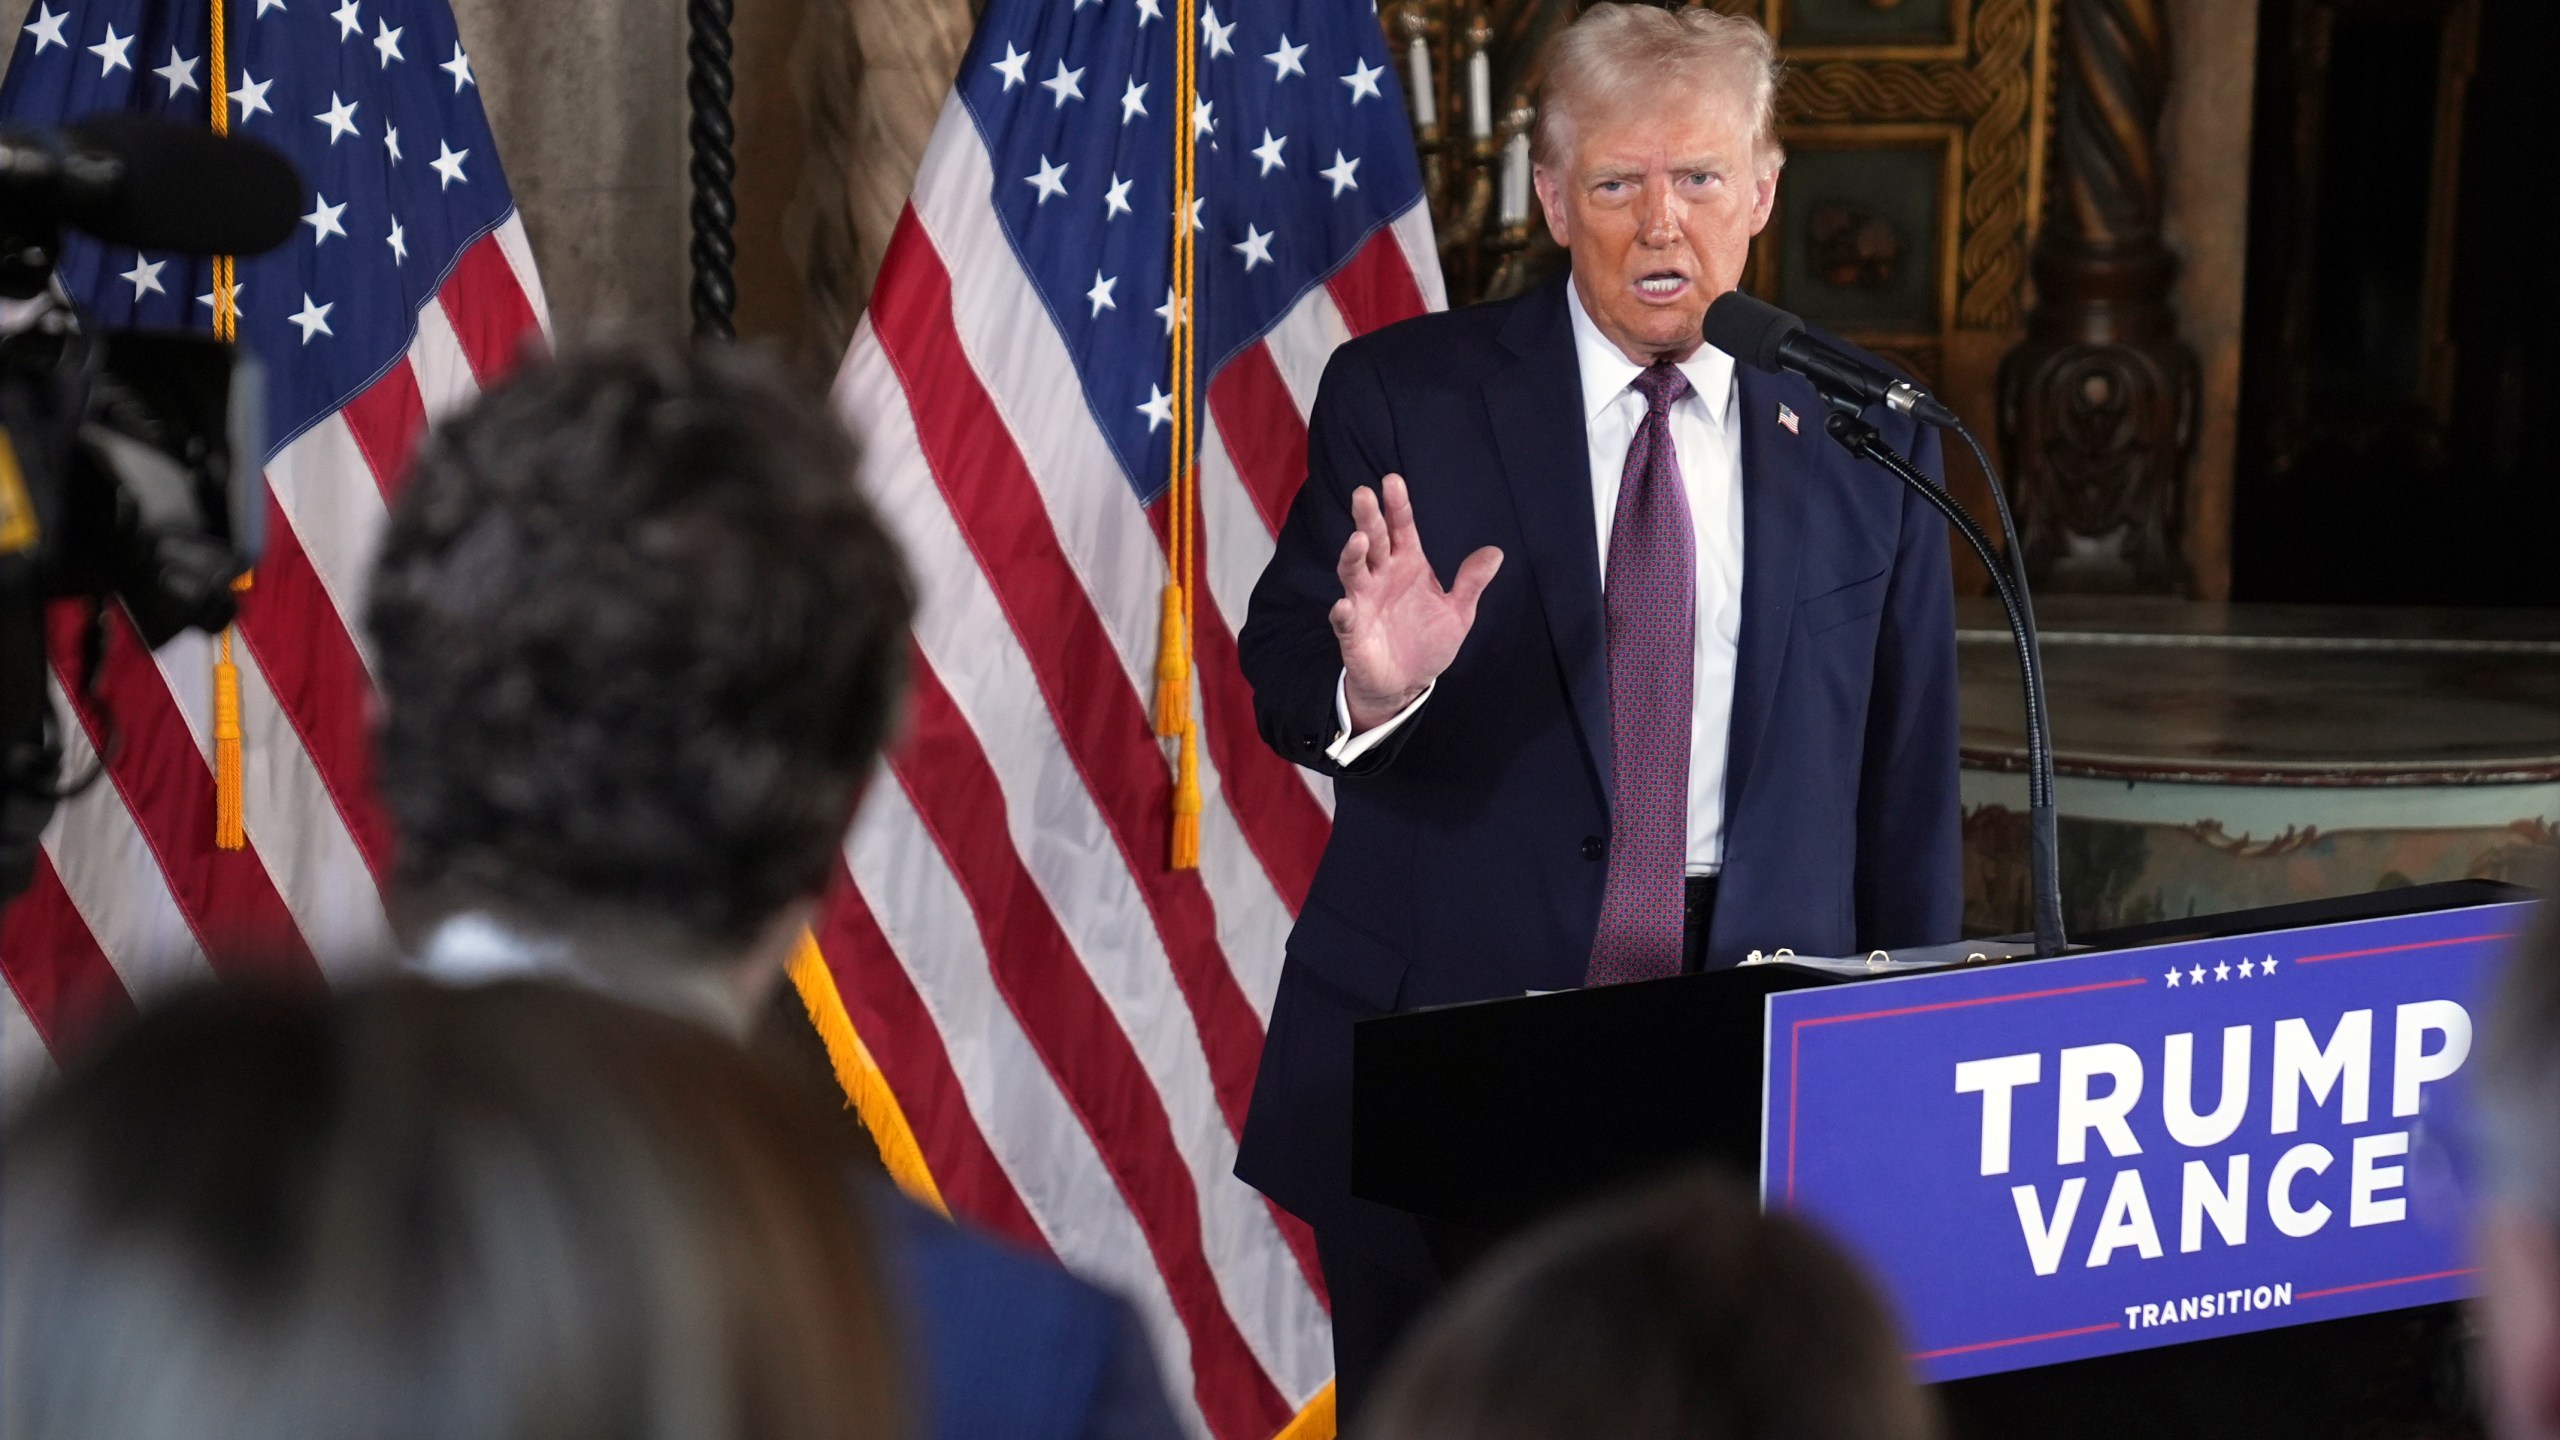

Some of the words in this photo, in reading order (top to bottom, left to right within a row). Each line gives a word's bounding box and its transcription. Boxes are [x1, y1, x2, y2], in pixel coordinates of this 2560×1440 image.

[1953, 998, 2474, 1178] TRUMP
[2010, 1130, 2410, 1278] VANCE
[2124, 1281, 2293, 1331] TRANSITION
